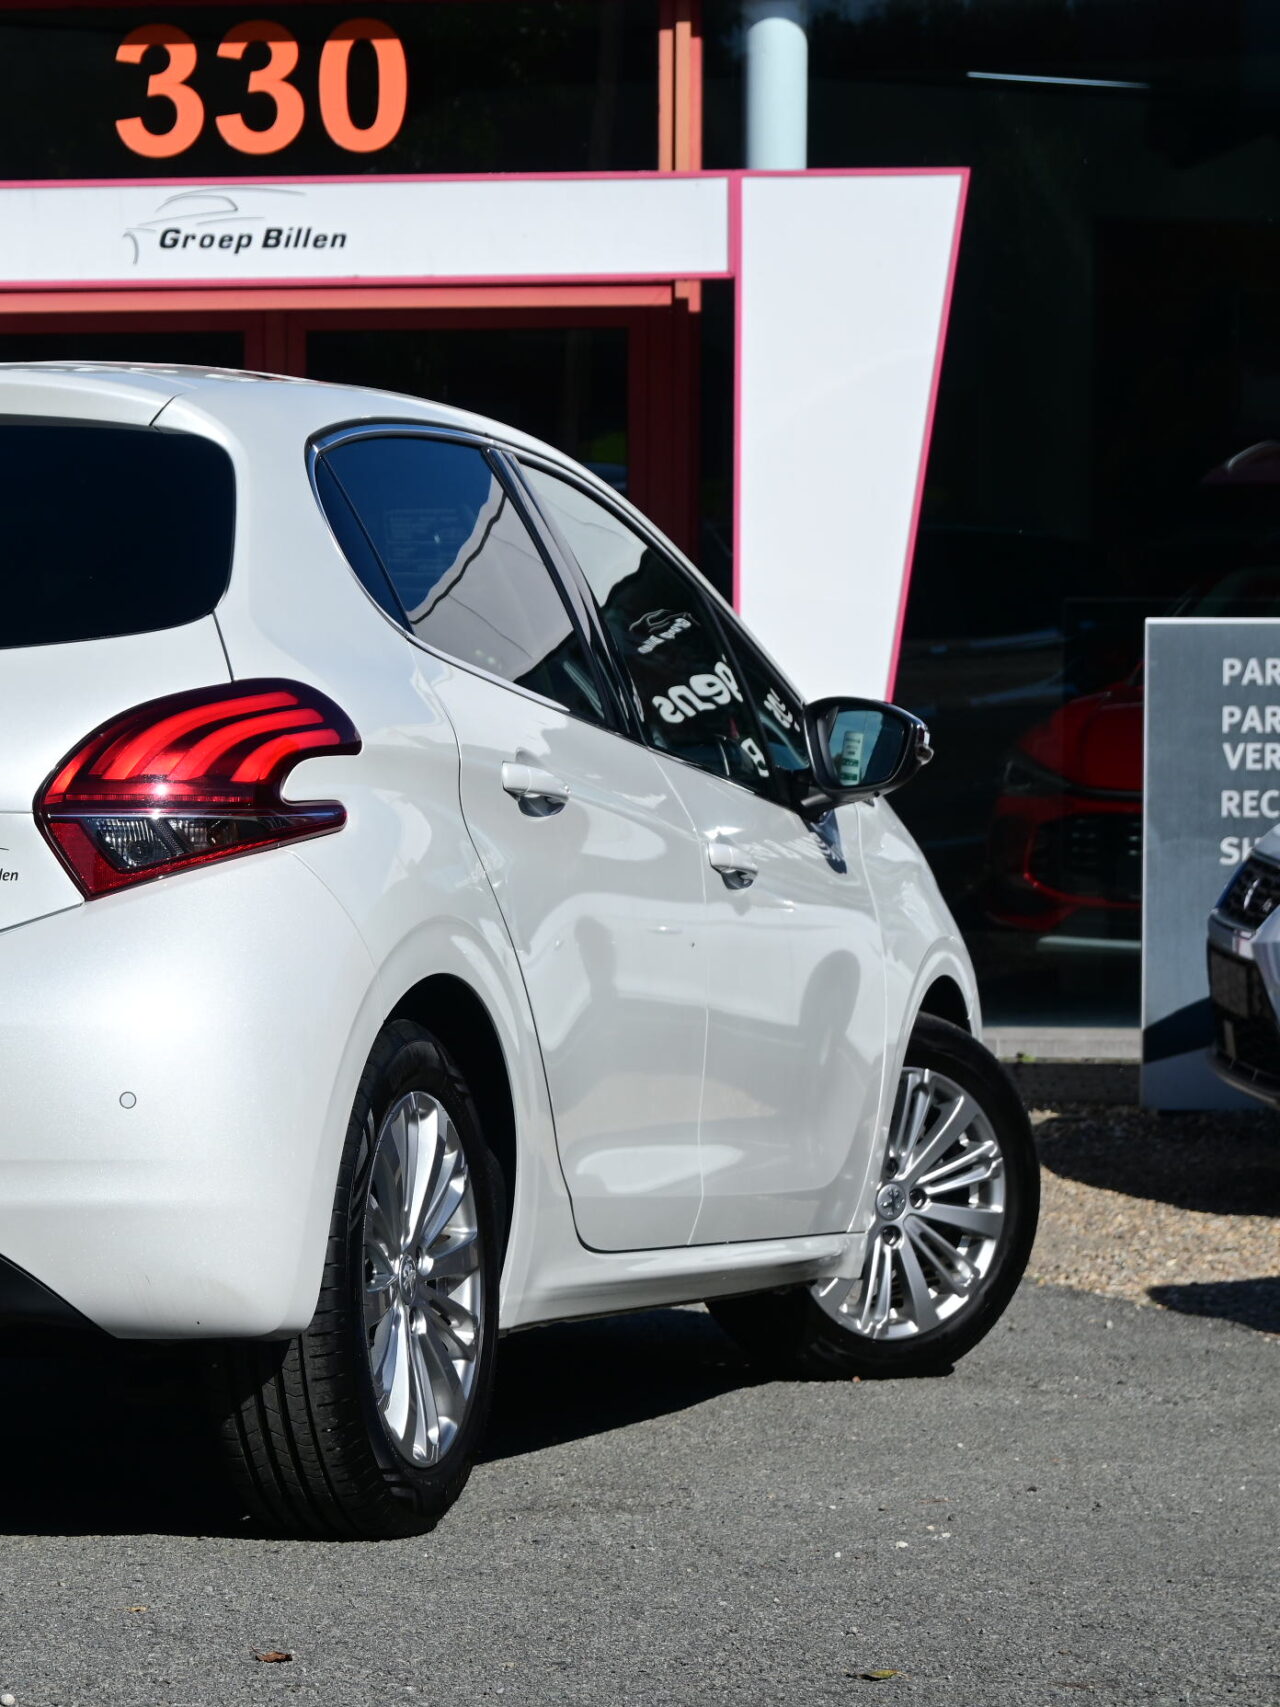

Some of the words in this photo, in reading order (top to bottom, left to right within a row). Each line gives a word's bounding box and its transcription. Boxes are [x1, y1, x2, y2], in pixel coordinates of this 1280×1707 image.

[114, 17, 408, 158] 330
[159, 228, 253, 254] Groep
[261, 227, 347, 250] Billen
